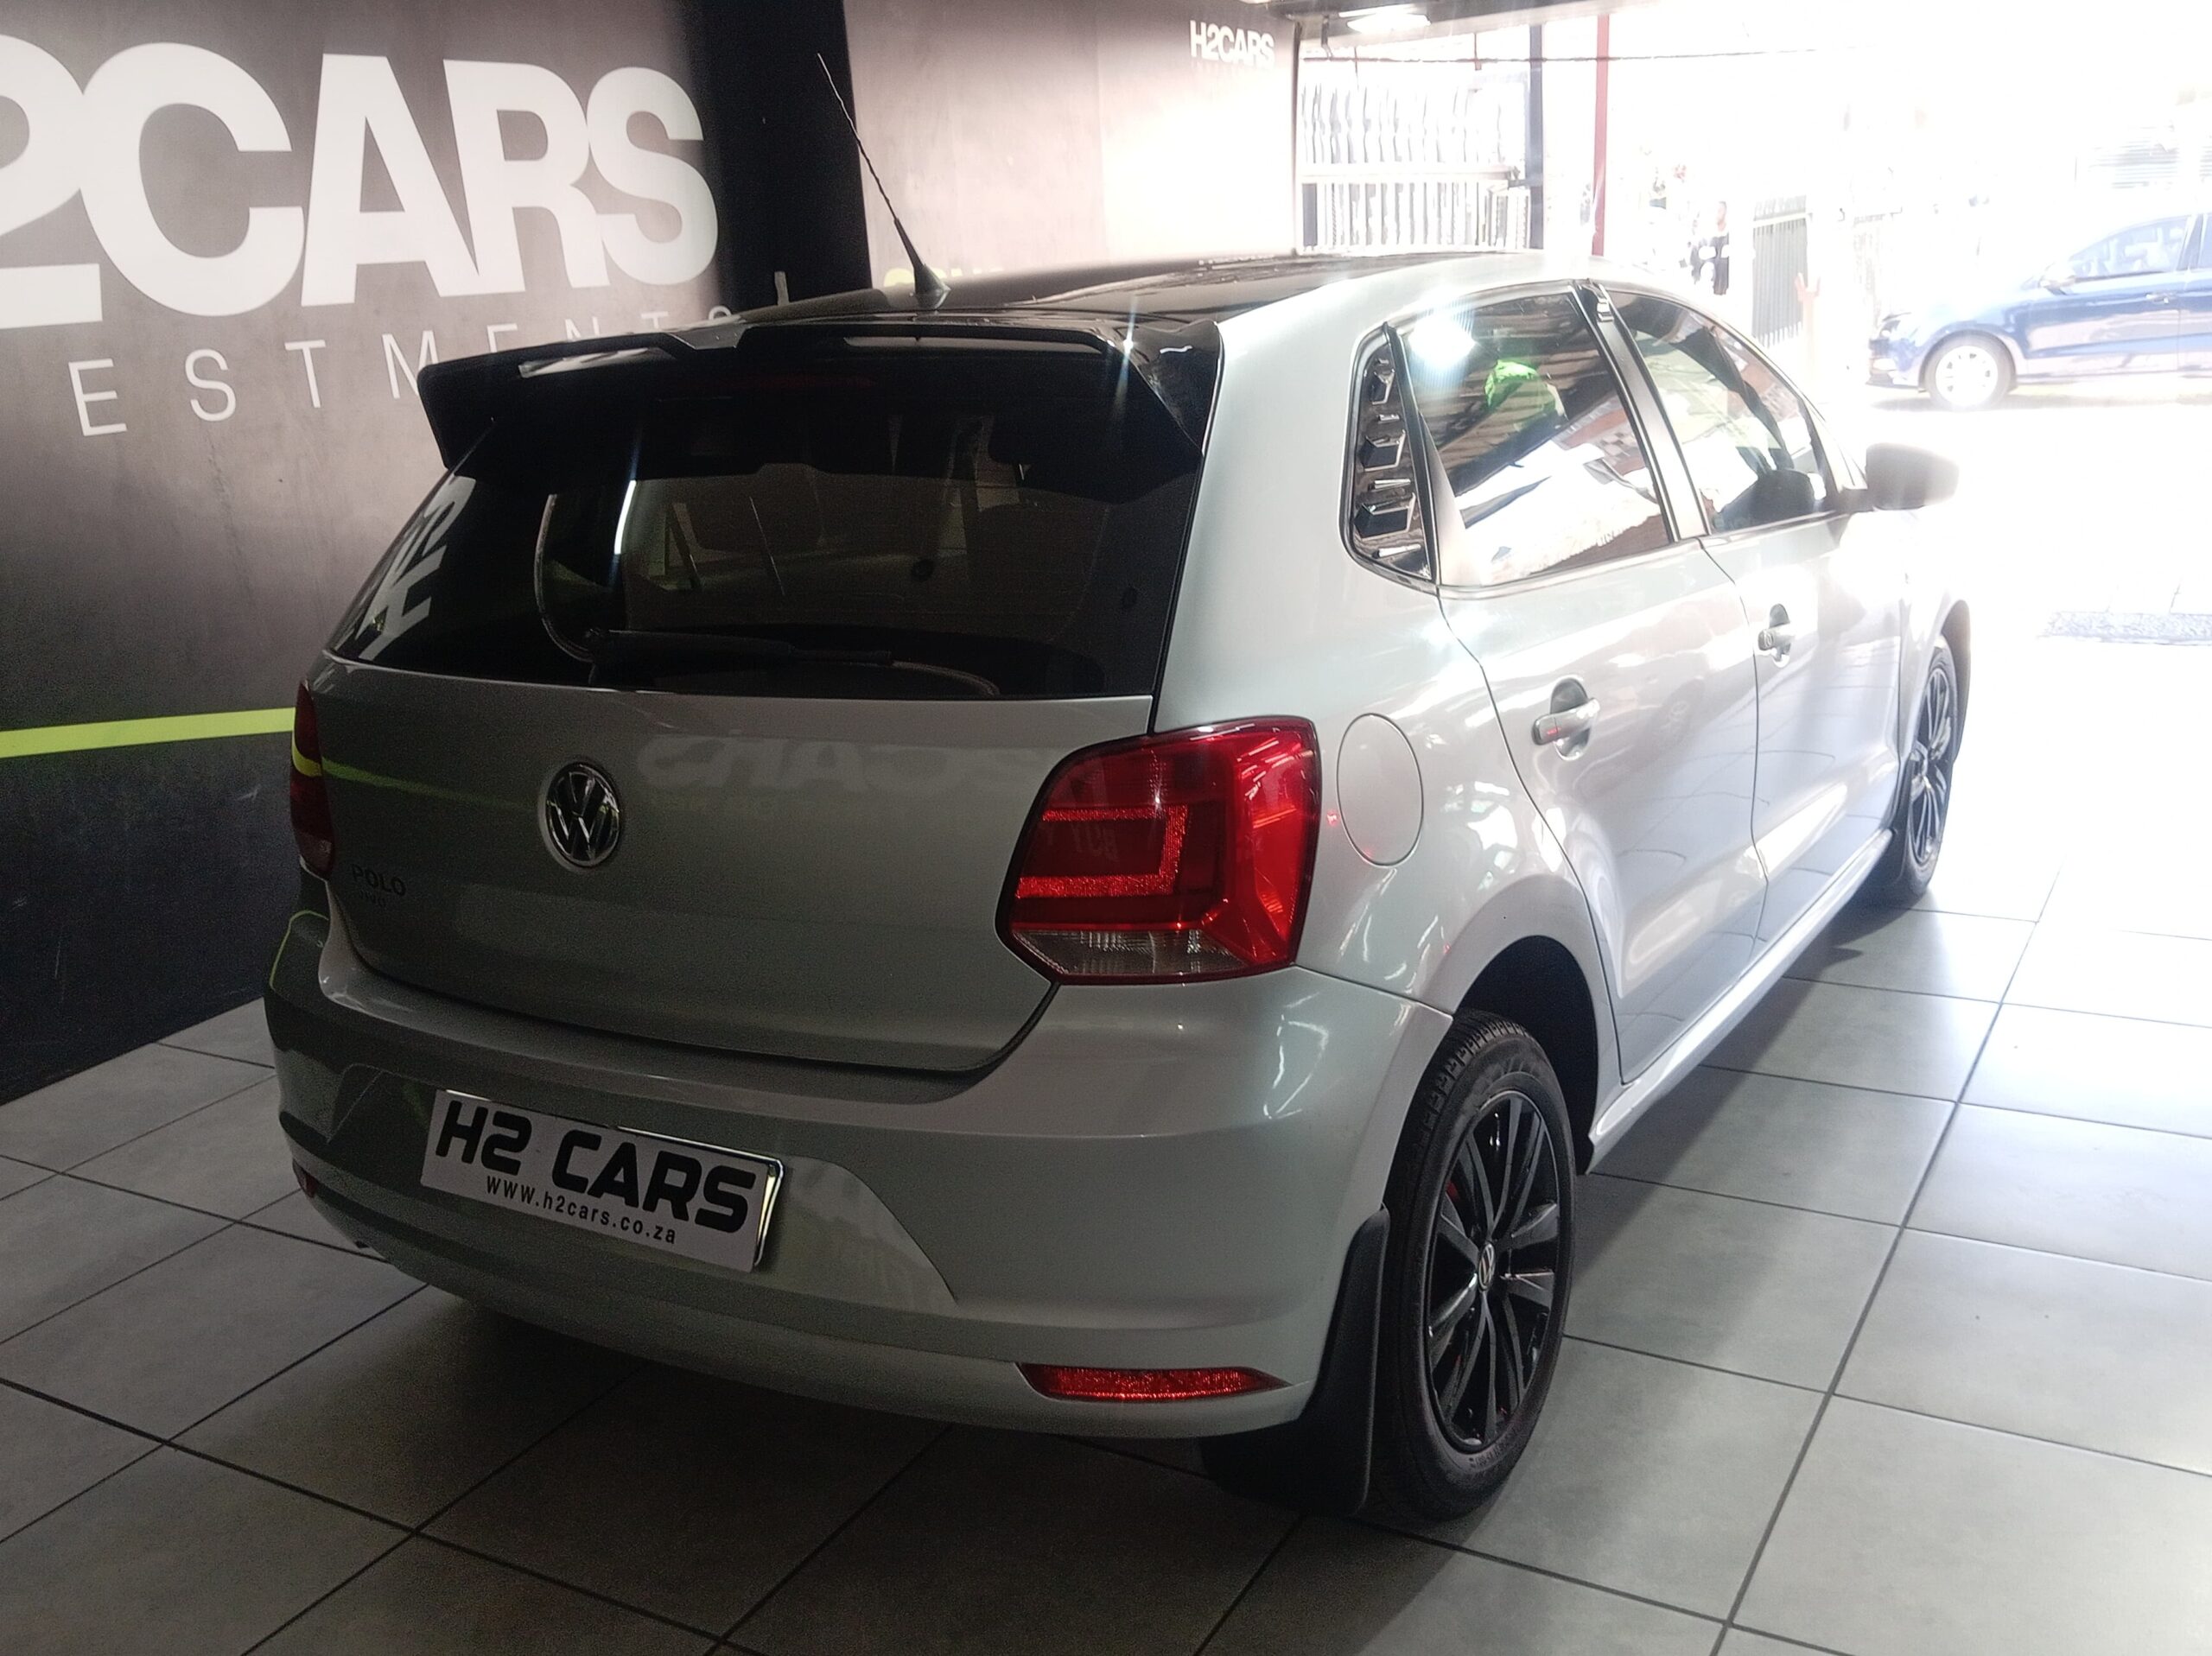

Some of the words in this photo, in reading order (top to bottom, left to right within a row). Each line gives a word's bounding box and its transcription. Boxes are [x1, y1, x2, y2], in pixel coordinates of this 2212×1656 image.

[1190, 19, 1275, 69] H2CARS
[350, 863, 407, 898] POLO
[435, 1100, 532, 1177] H2
[550, 1128, 757, 1234] CARS
[486, 1175, 677, 1245] www.h2cars.co.za
